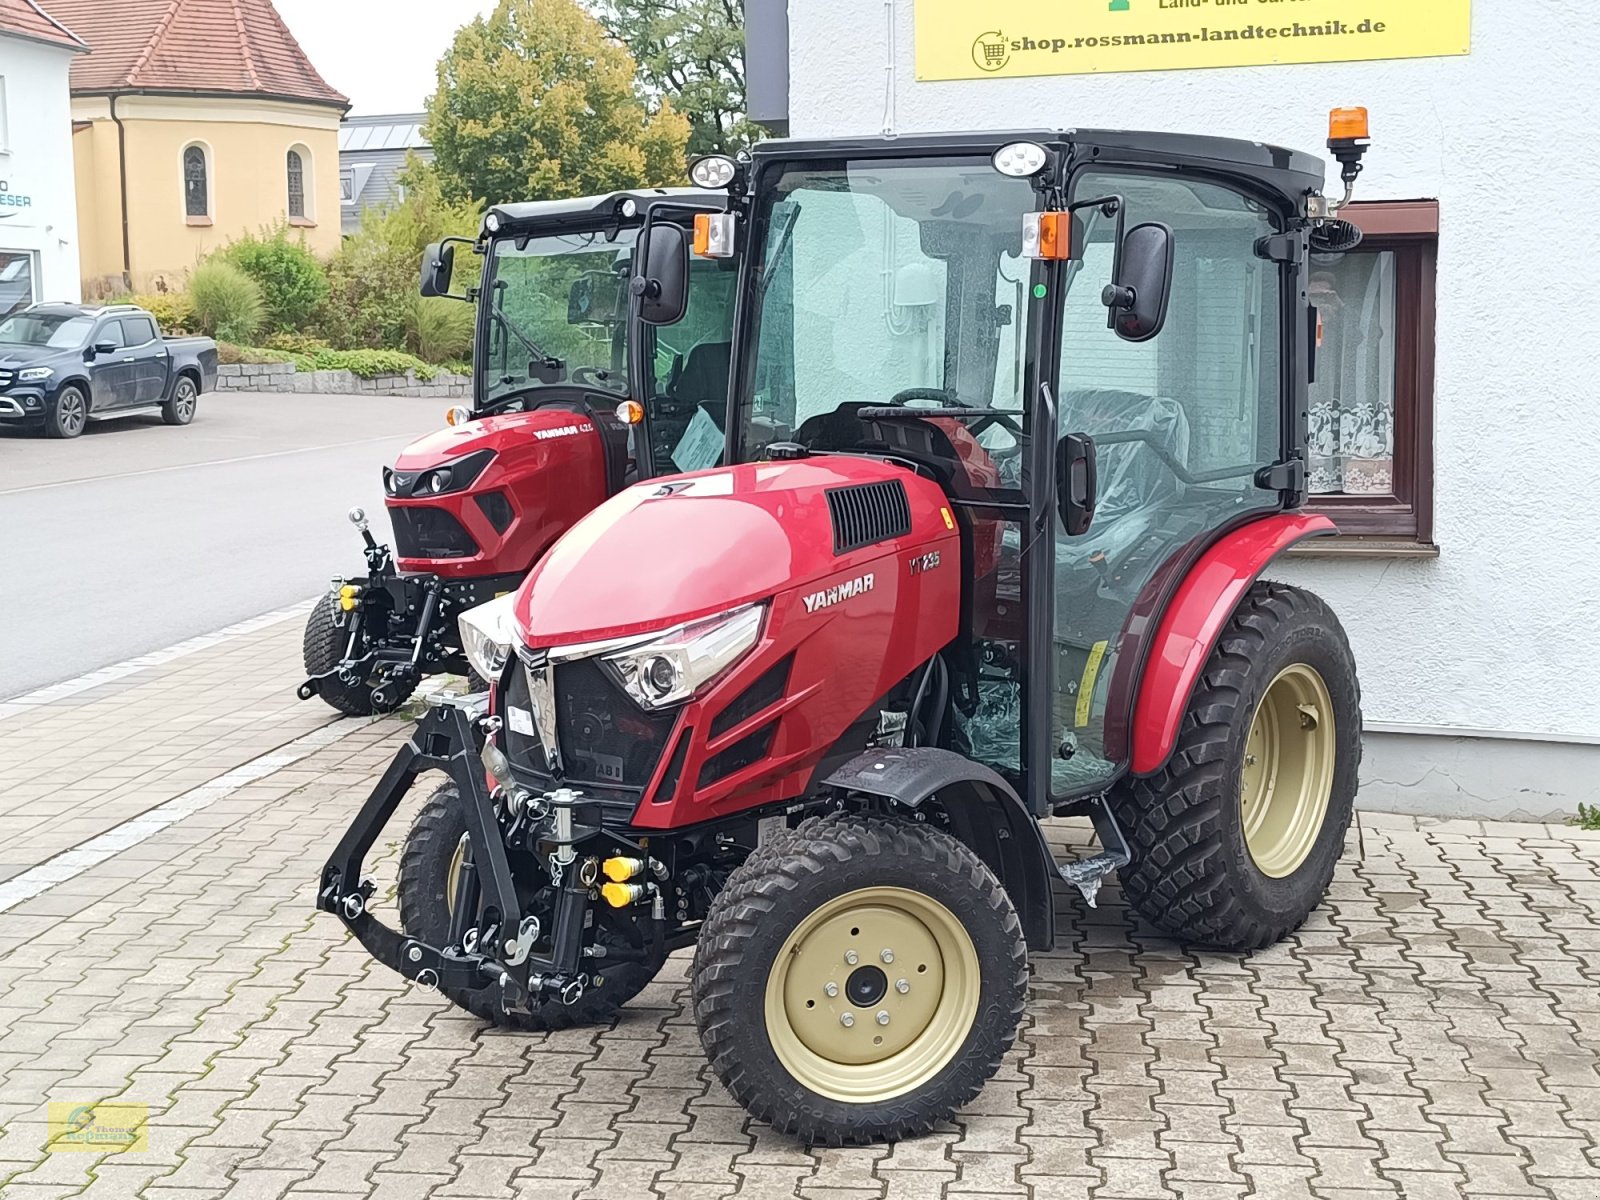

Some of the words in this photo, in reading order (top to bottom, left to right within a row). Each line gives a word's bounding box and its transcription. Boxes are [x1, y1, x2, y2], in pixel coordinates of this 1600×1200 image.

[1010, 19, 1387, 53] shop.rossmann-landtechnik.de
[532, 425, 579, 440] YANMAR
[908, 550, 941, 576] YT235
[802, 572, 875, 614] YANMAR
